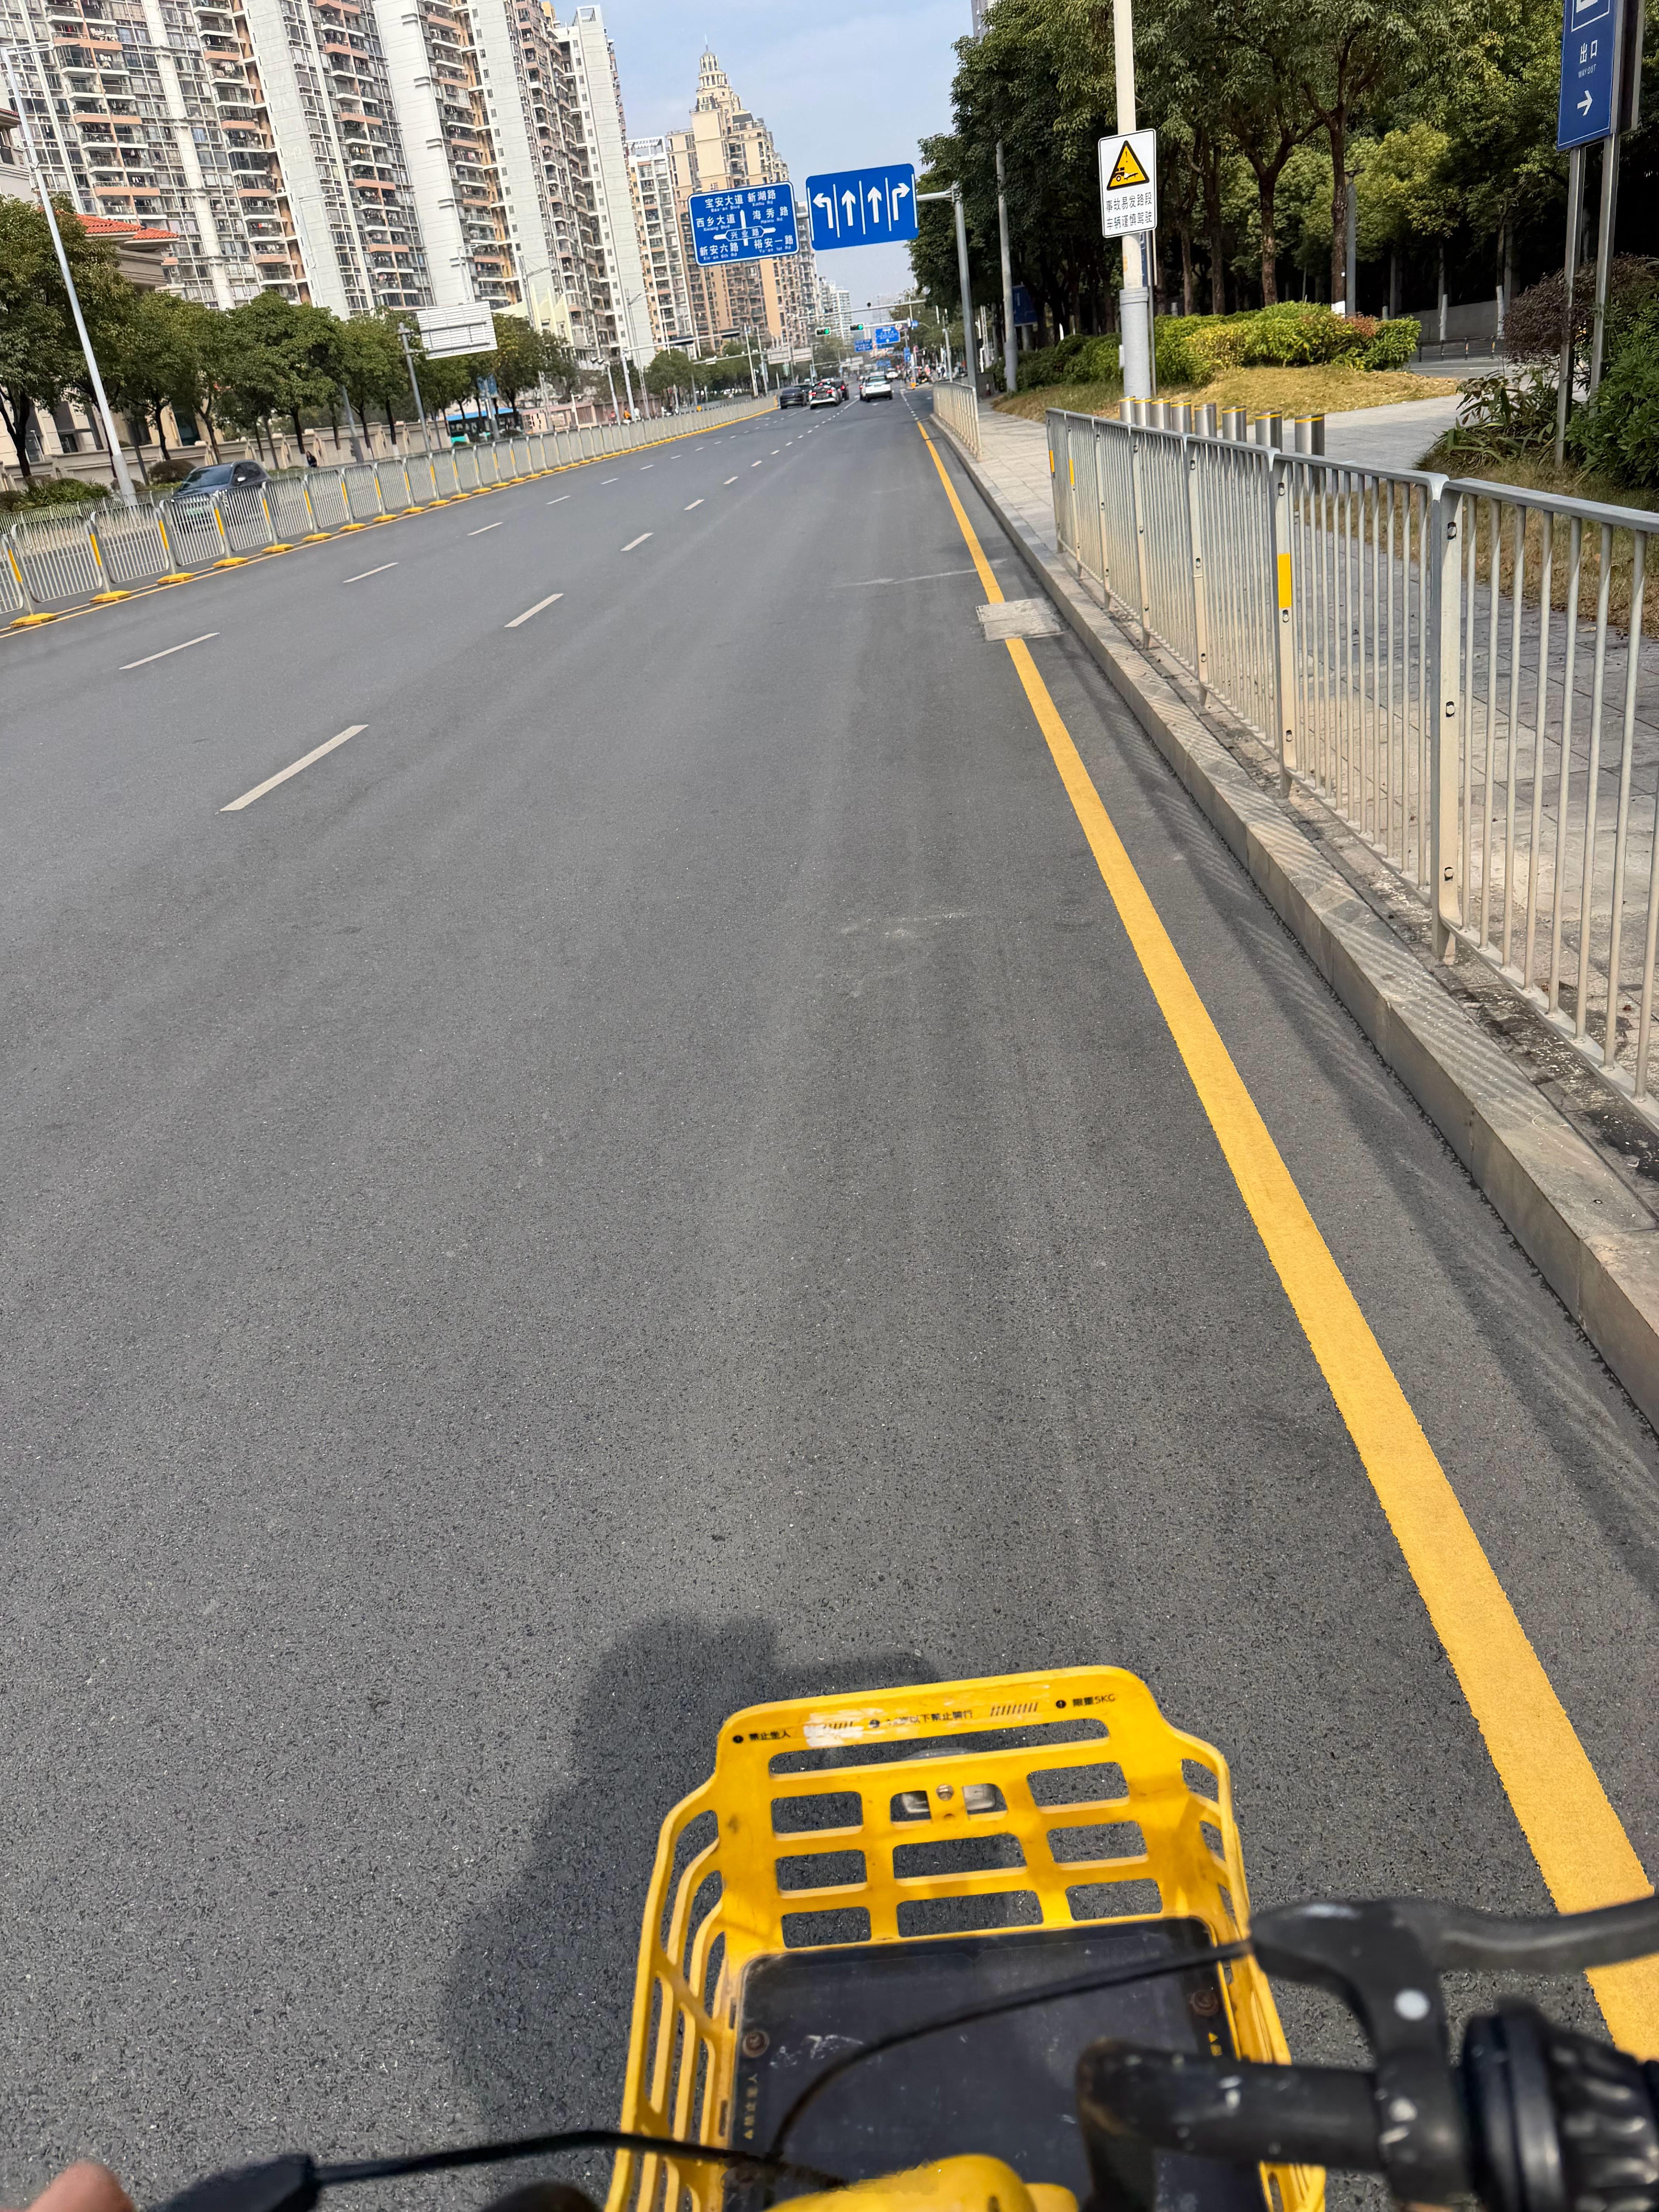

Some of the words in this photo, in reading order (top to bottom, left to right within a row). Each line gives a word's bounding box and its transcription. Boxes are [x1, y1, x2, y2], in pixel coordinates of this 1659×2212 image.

[1580, 40, 1597, 64] 出口
[1588, 64, 1596, 74] OUT
[705, 194, 744, 208] 宝安大道
[747, 189, 776, 203] 新湖路
[1106, 192, 1152, 213] 事故易发路段
[696, 213, 736, 228] 西乡大道
[752, 206, 788, 220] 海秀路
[1106, 210, 1152, 230] 车辆谨慎驾驶
[730, 228, 759, 240] 兴业路
[699, 242, 738, 257] 新安六路
[754, 235, 793, 250] 裕安一路
